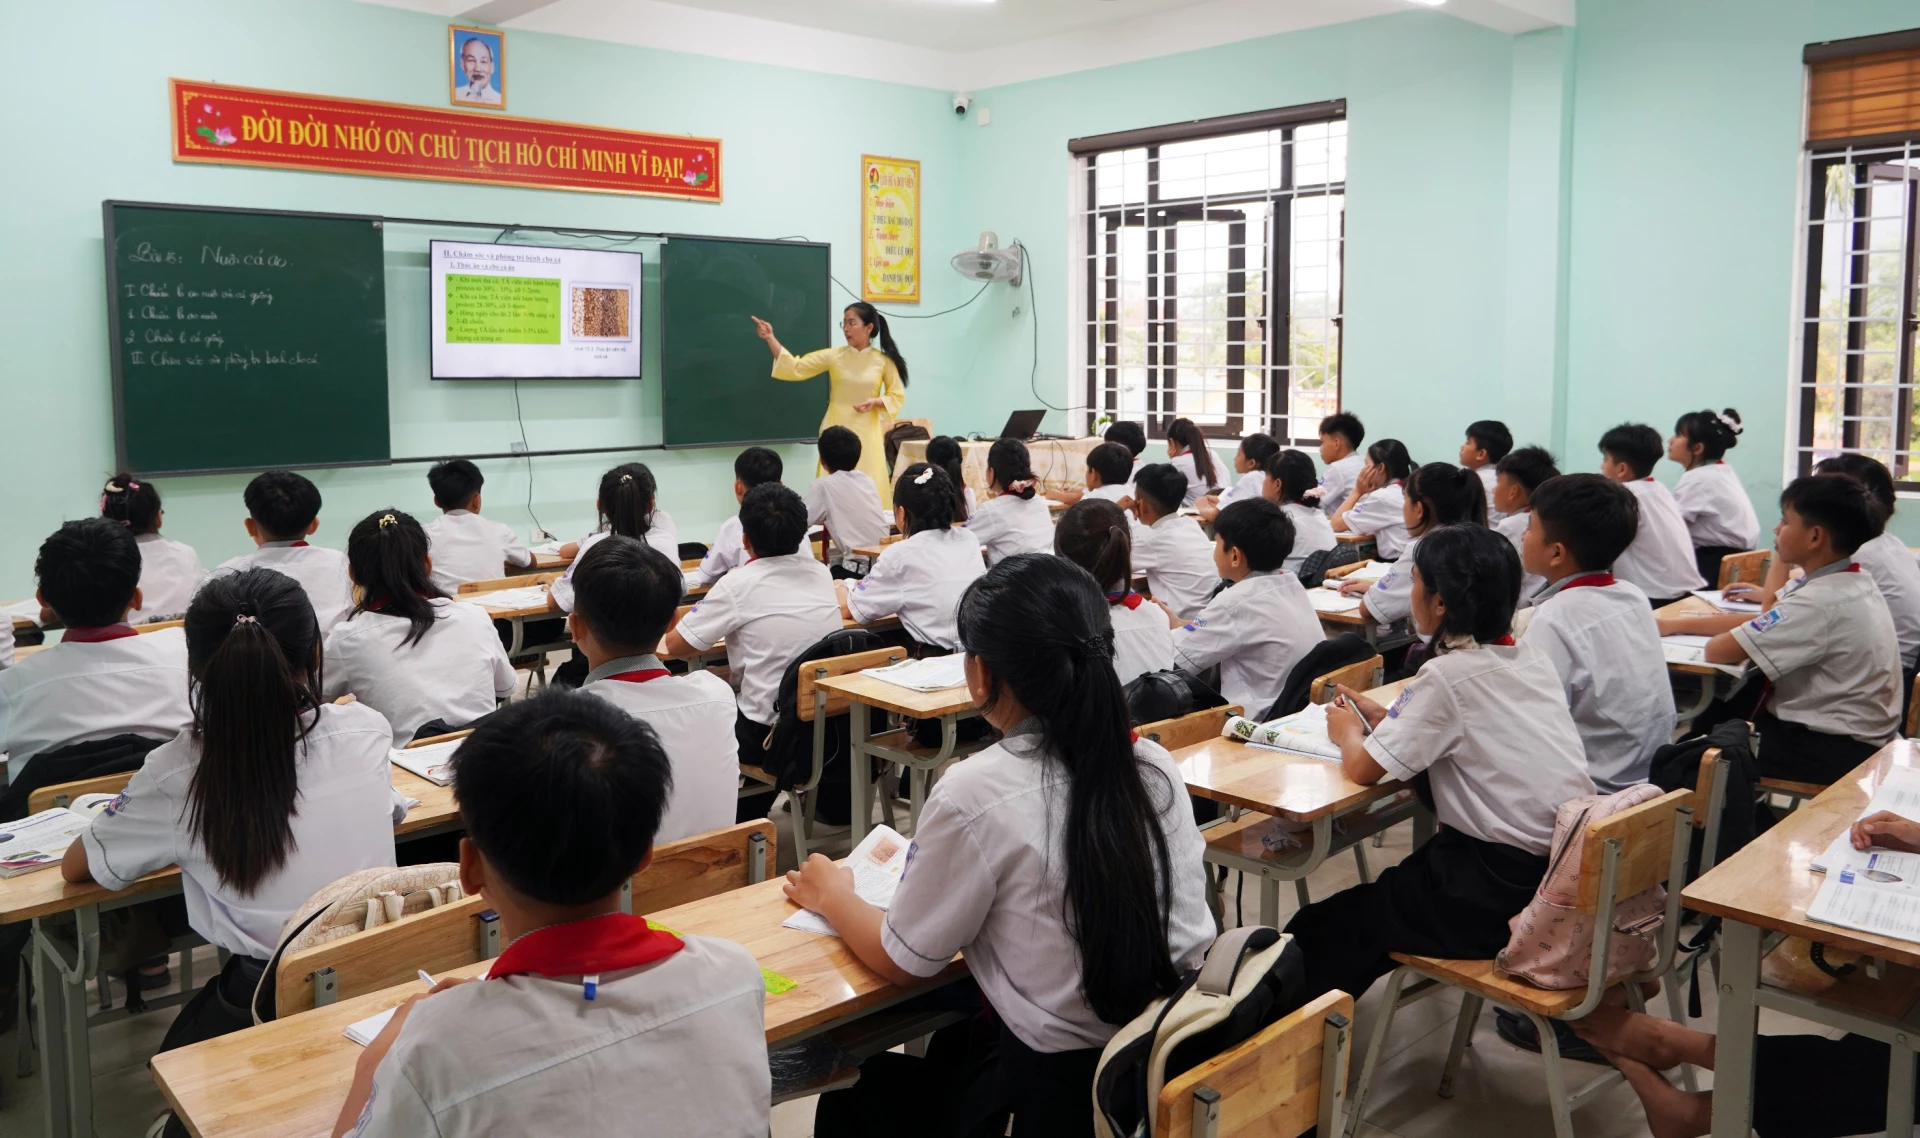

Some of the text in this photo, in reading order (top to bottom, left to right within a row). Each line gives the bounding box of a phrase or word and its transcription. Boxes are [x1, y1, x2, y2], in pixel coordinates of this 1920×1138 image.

[240, 108, 685, 183] ĐỜI ĐỜI NHỚ ƠN CHỦ TỊCH HỒ CHÍ MINH VĨ ĐẠI!
[243, 249, 265, 267] cá
